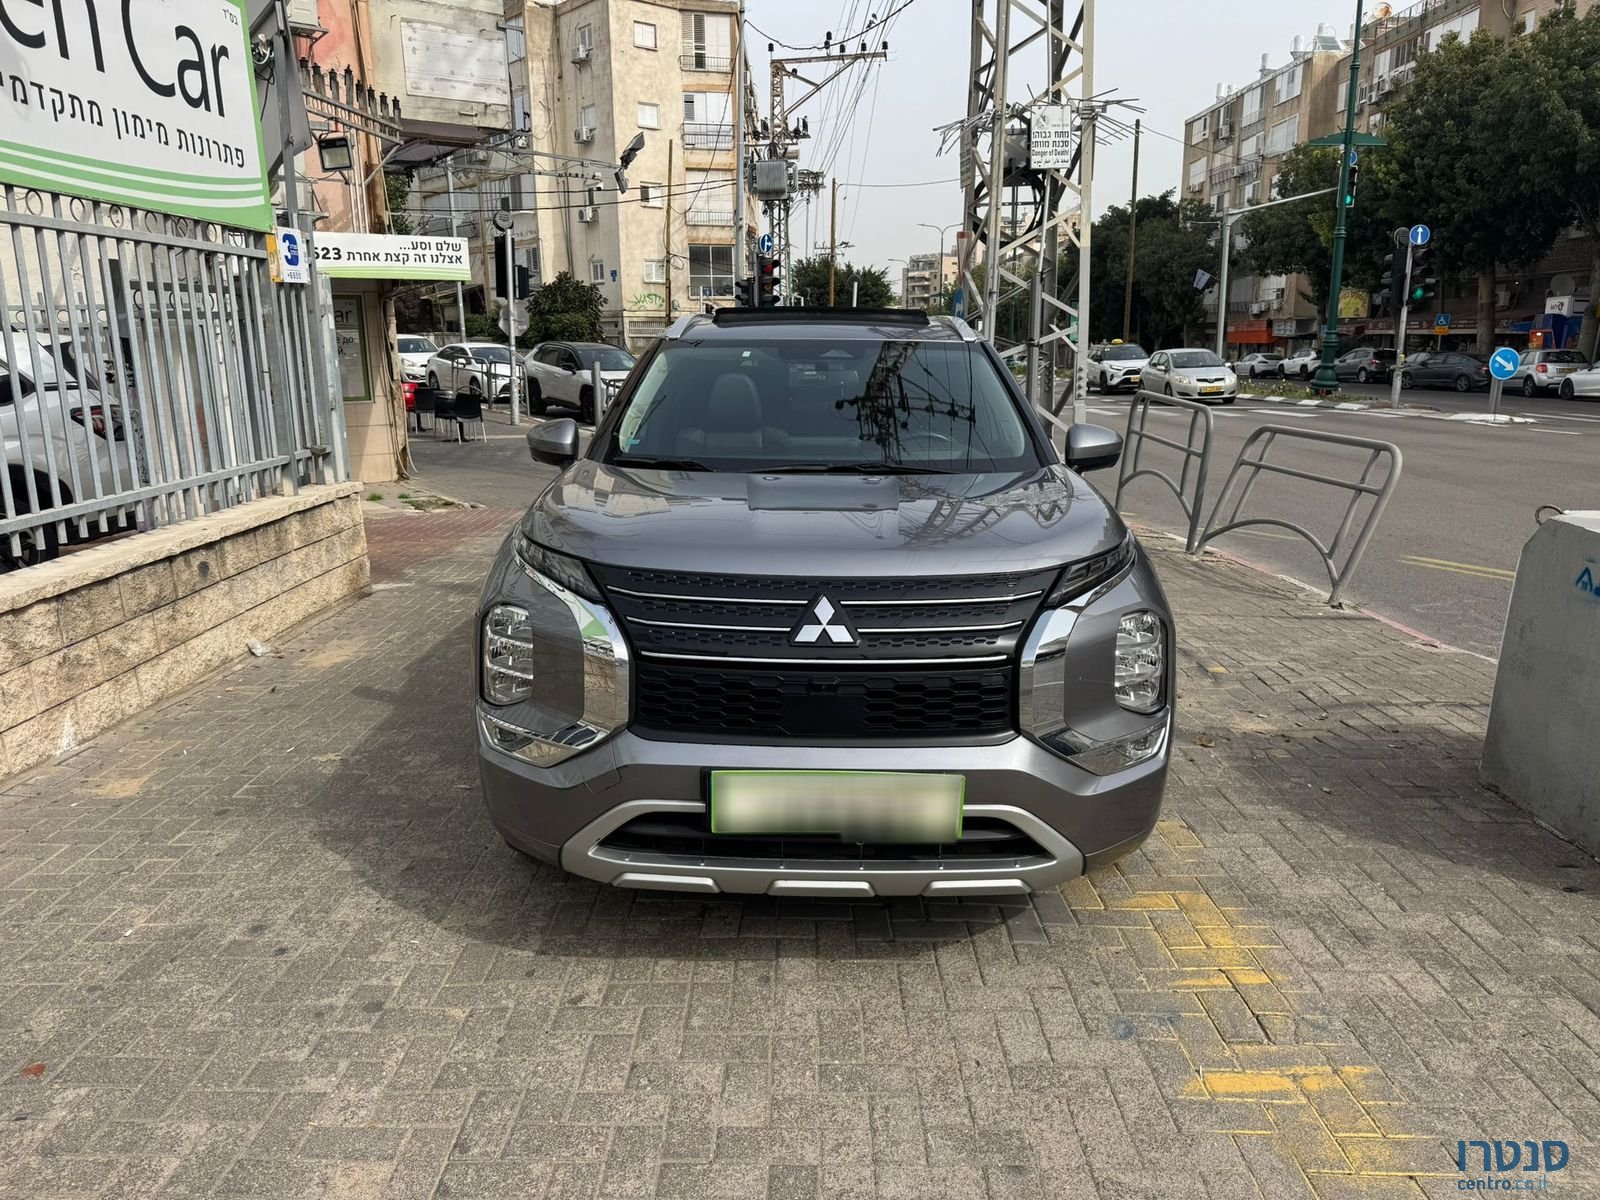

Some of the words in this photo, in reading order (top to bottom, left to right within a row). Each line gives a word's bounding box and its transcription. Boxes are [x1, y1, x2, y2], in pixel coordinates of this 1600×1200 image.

[121, 0, 230, 118] Car
[112, 107, 169, 146] מימון
[1054, 130, 1069, 138] מתח
[176, 128, 245, 168] פתרונות
[1032, 149, 1048, 157] Danger
[436, 240, 462, 252] שלם
[347, 251, 381, 262] אחרת
[384, 252, 410, 264] קצת
[414, 253, 426, 263] זה
[431, 252, 463, 264] אצלנו
